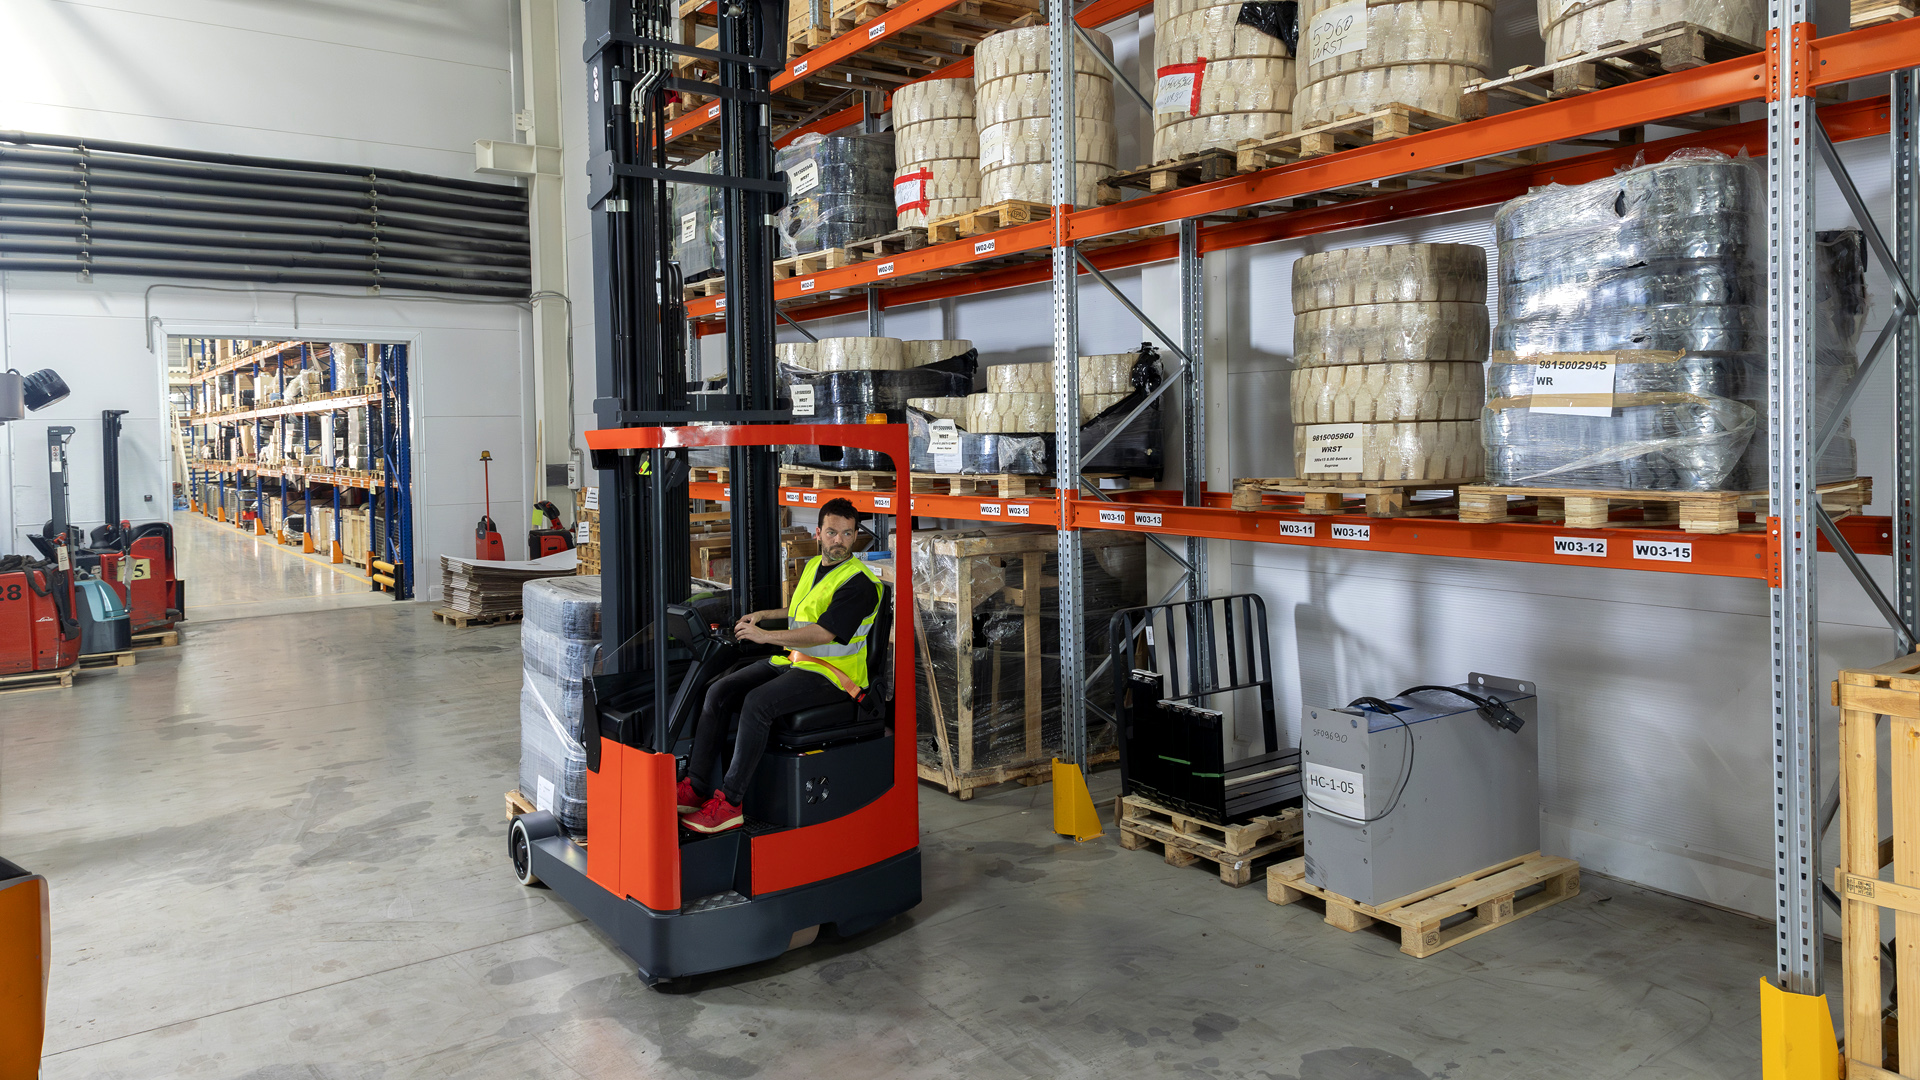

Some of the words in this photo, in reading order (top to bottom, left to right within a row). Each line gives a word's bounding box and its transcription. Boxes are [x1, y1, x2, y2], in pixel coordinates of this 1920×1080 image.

[1313, 15, 1354, 47] 5960
[1312, 35, 1348, 60] WRST
[975, 242, 995, 253] W02-09
[1539, 360, 1608, 370] 9815002945
[1536, 376, 1554, 386] WR
[1312, 432, 1354, 442] 9815005960
[1321, 445, 1343, 453] WRST
[981, 506, 1000, 514] W02-12
[1008, 507, 1029, 515] W02-15
[1101, 512, 1125, 522] W03-10
[1136, 514, 1162, 524] W03-13
[1280, 524, 1313, 534] W03-11
[1333, 527, 1370, 538] W03-14
[1554, 540, 1605, 553] W03-12
[1635, 544, 1691, 559] W03-15
[1313, 728, 1348, 743] SF09690
[1310, 774, 1355, 794] HC-1-05
